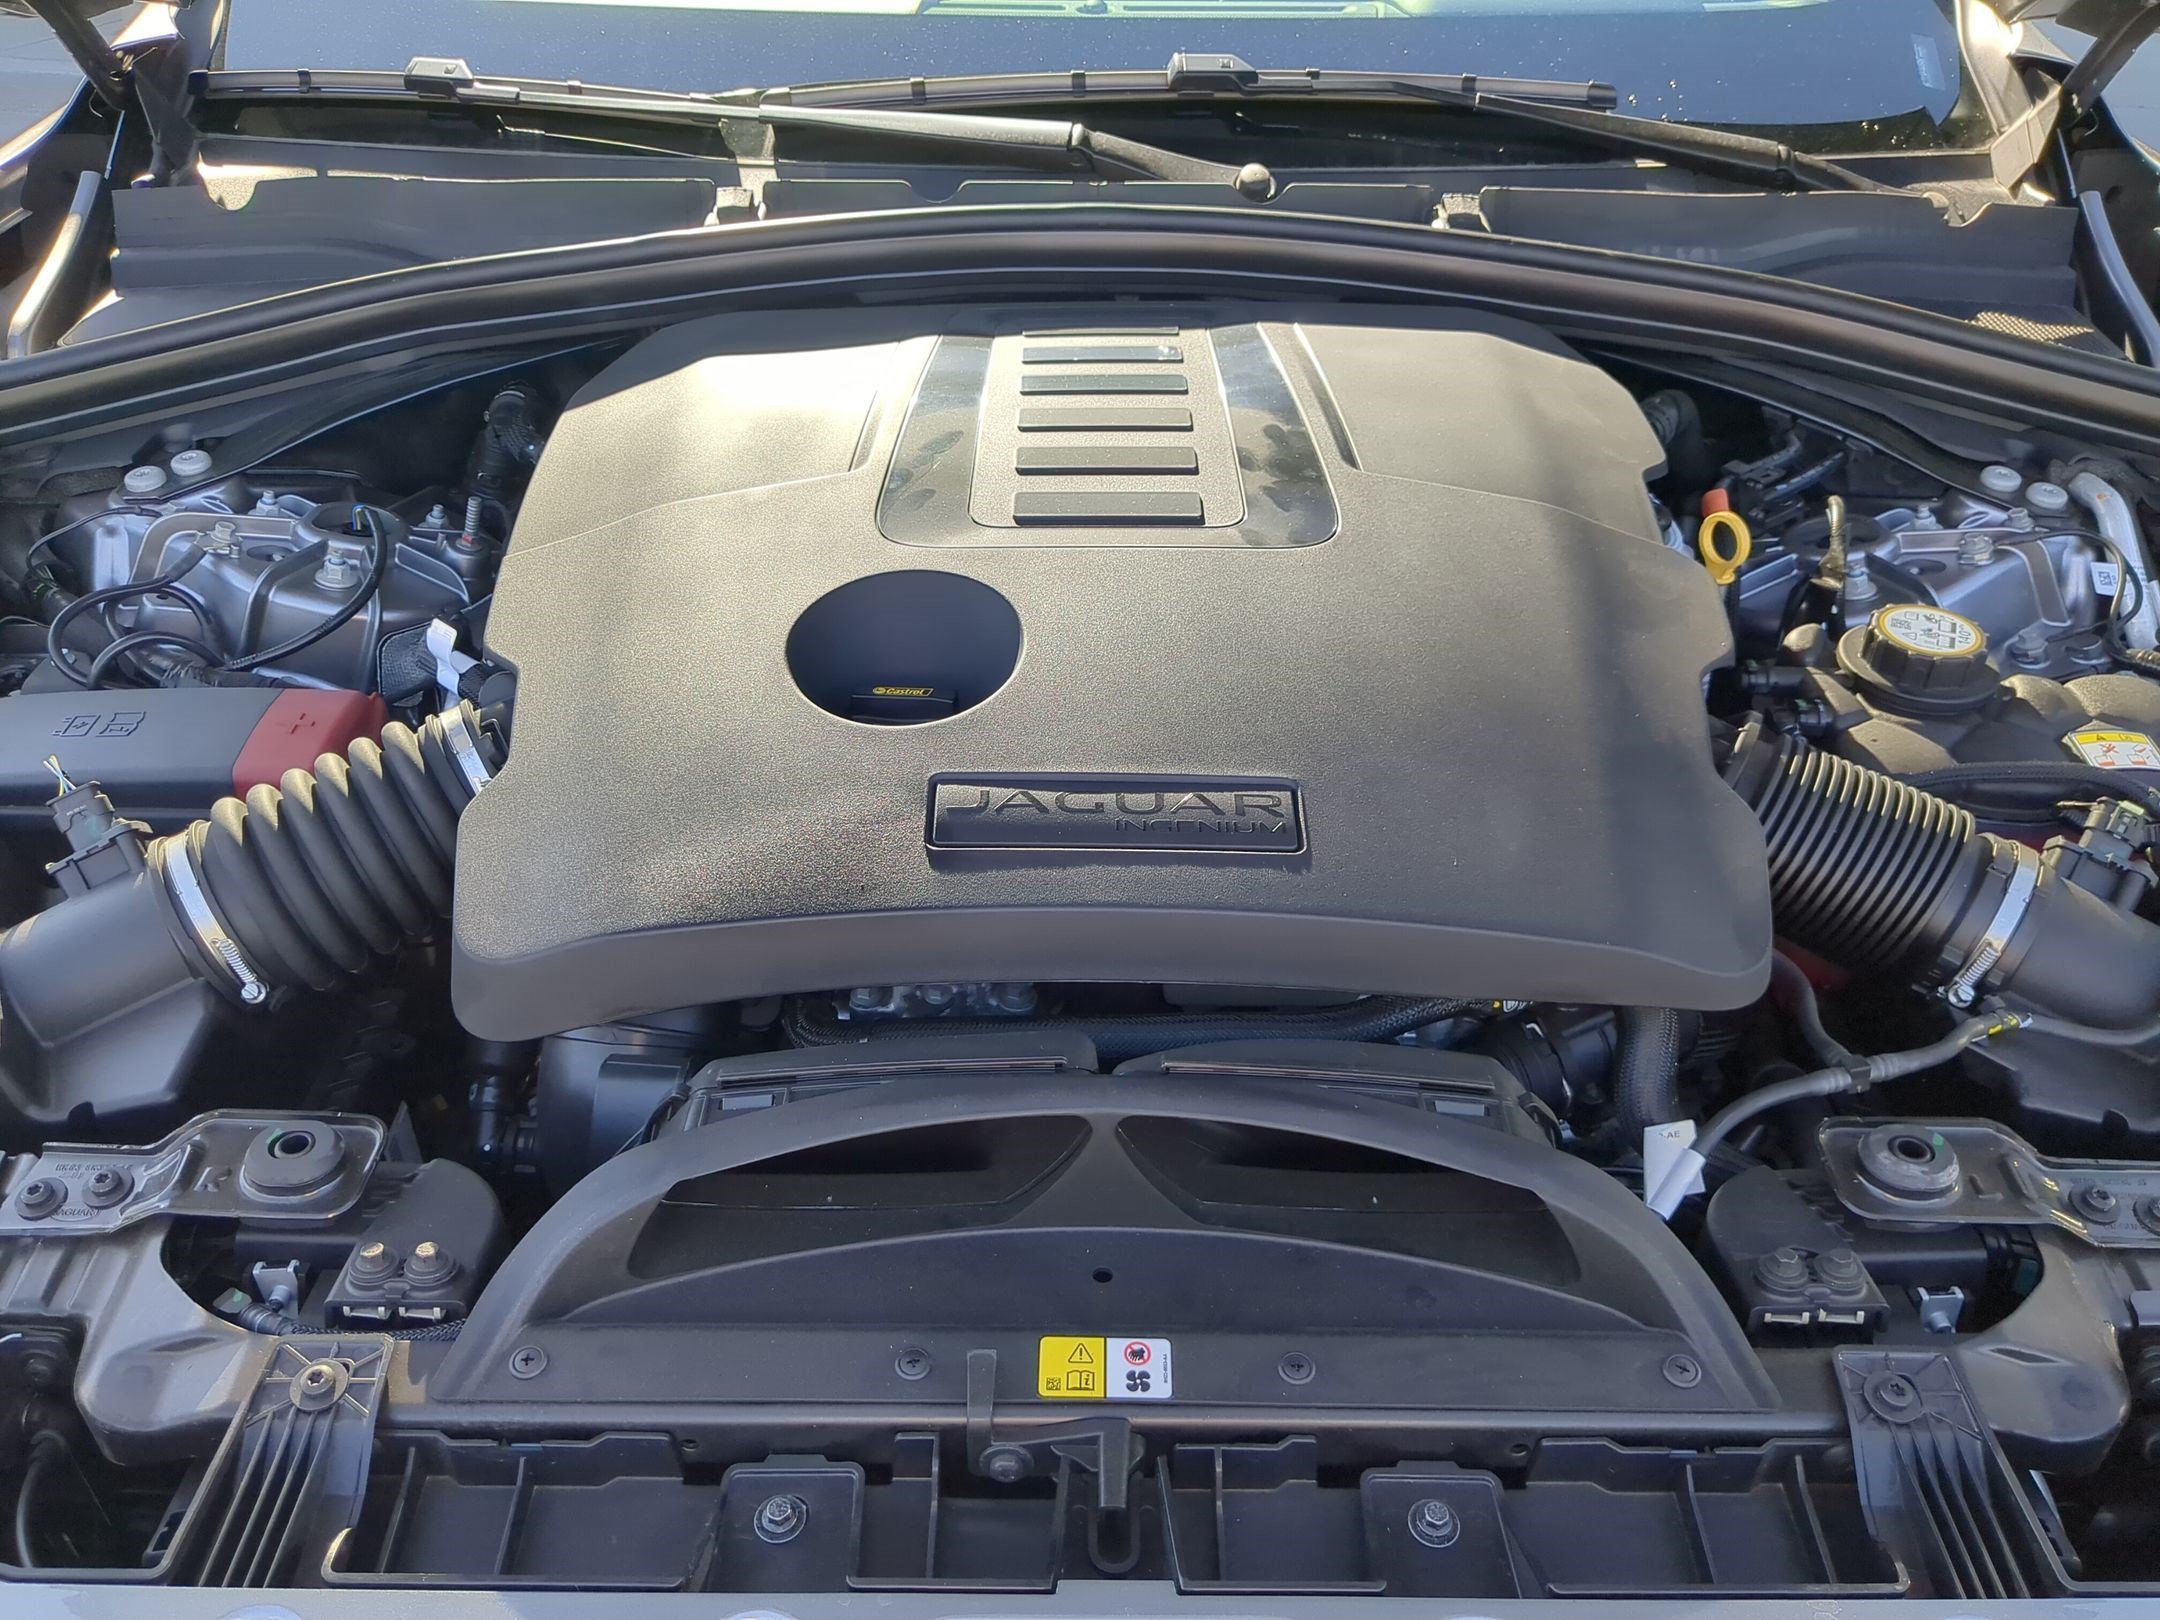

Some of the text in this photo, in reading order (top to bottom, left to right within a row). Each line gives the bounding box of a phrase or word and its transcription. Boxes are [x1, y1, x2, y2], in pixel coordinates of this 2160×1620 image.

[886, 687, 924, 696] Castrol
[945, 790, 1285, 817] JAGUAR
[1115, 819, 1286, 833] INGENIUM
